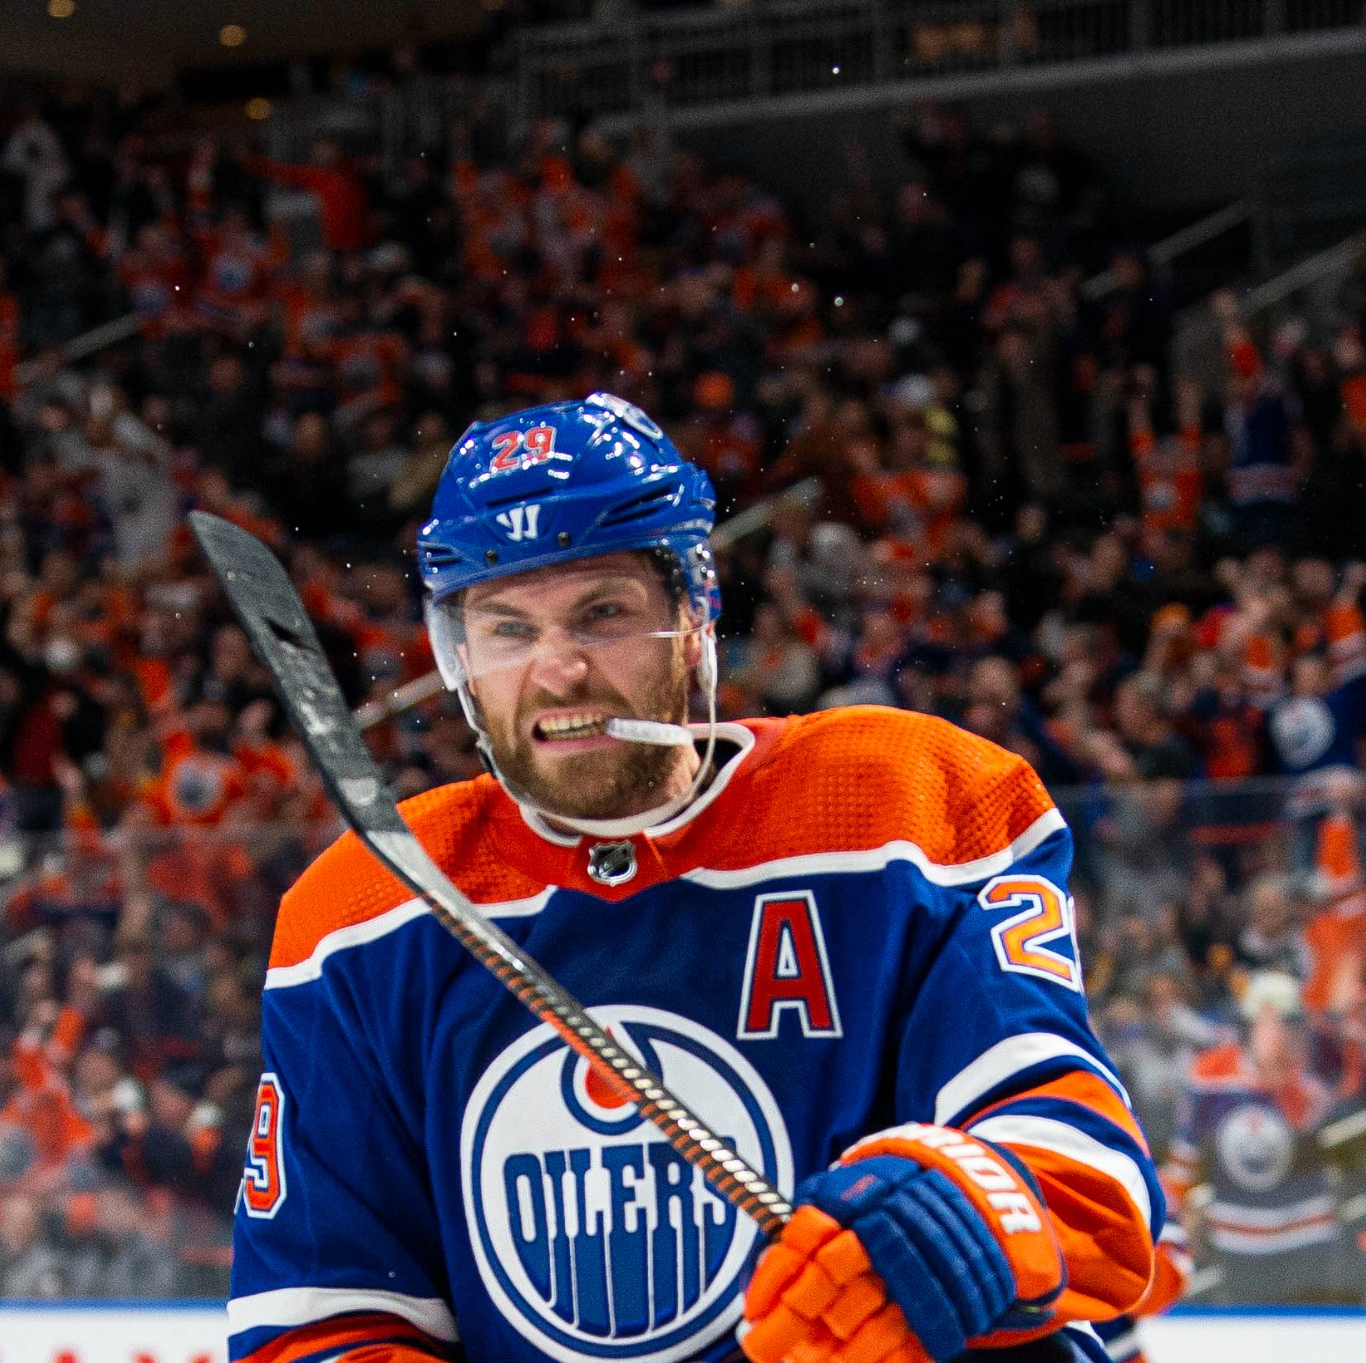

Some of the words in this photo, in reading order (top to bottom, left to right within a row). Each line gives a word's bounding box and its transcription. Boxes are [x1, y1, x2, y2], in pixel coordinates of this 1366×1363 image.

[490, 425, 557, 473] 29
[736, 889, 843, 1040] A
[977, 874, 1085, 993] 2
[233, 1071, 288, 1220] 9
[503, 1136, 737, 1338] OILERS
